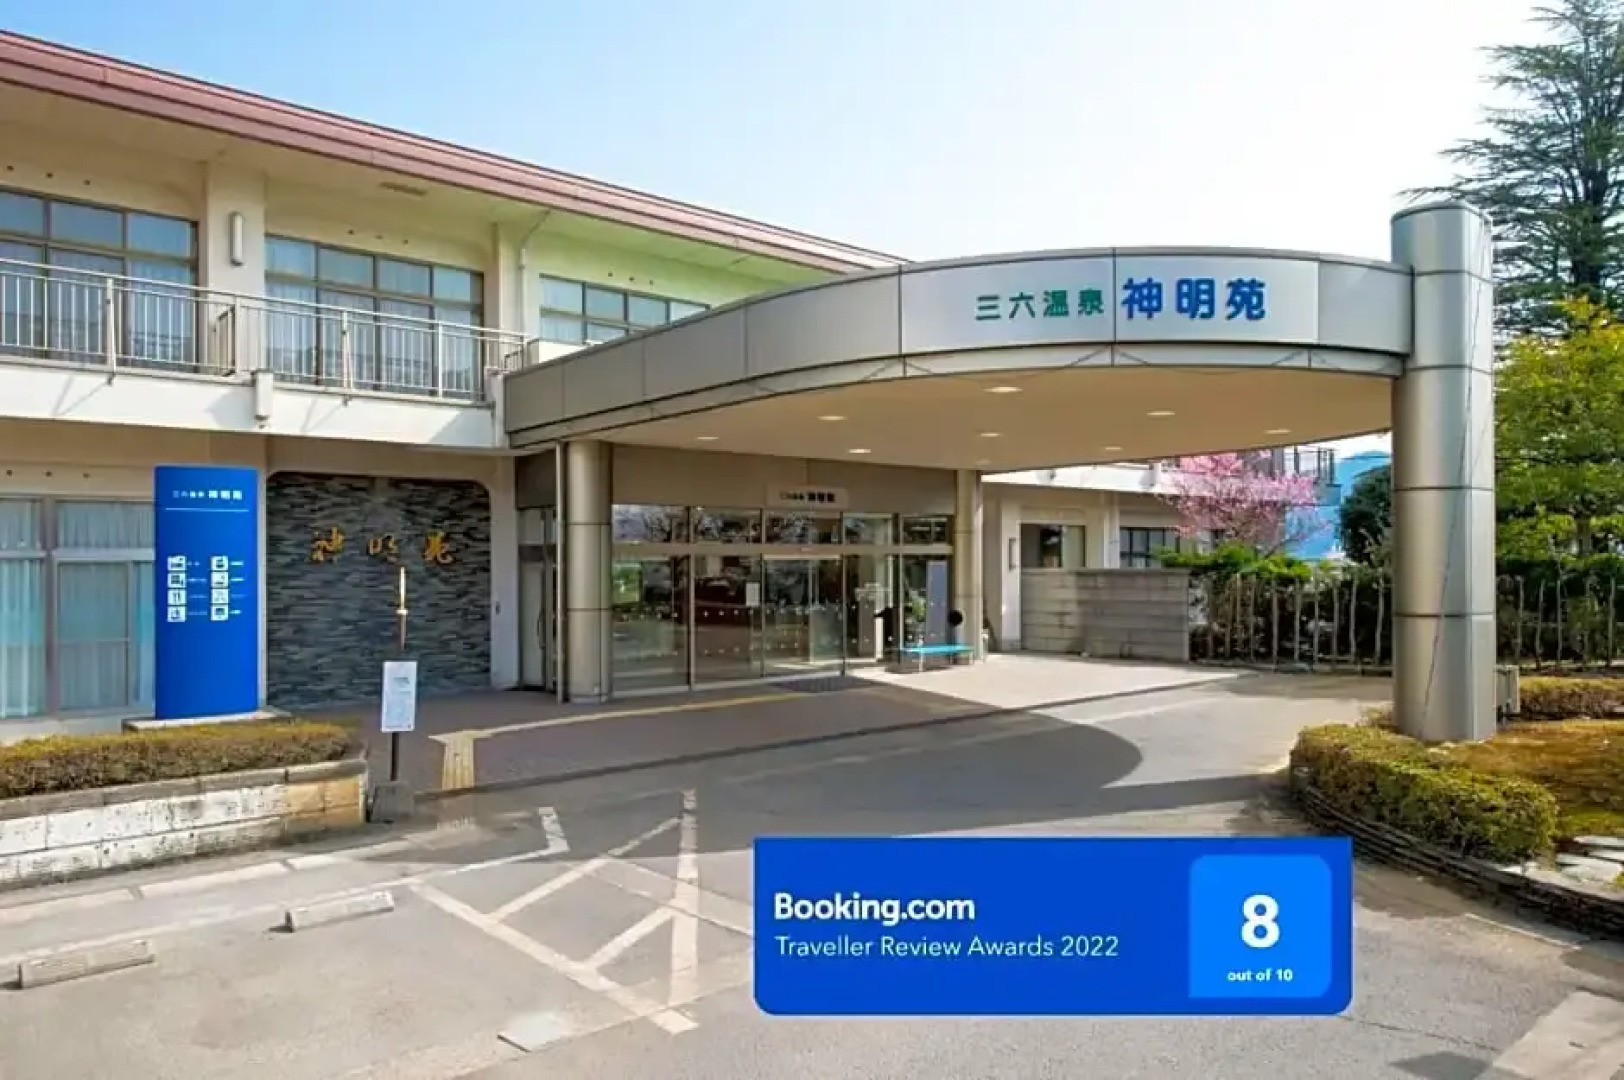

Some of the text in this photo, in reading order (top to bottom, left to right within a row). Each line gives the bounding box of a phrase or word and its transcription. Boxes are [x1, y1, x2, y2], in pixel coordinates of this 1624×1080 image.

[975, 277, 1267, 321] 三六温泉 神明苑
